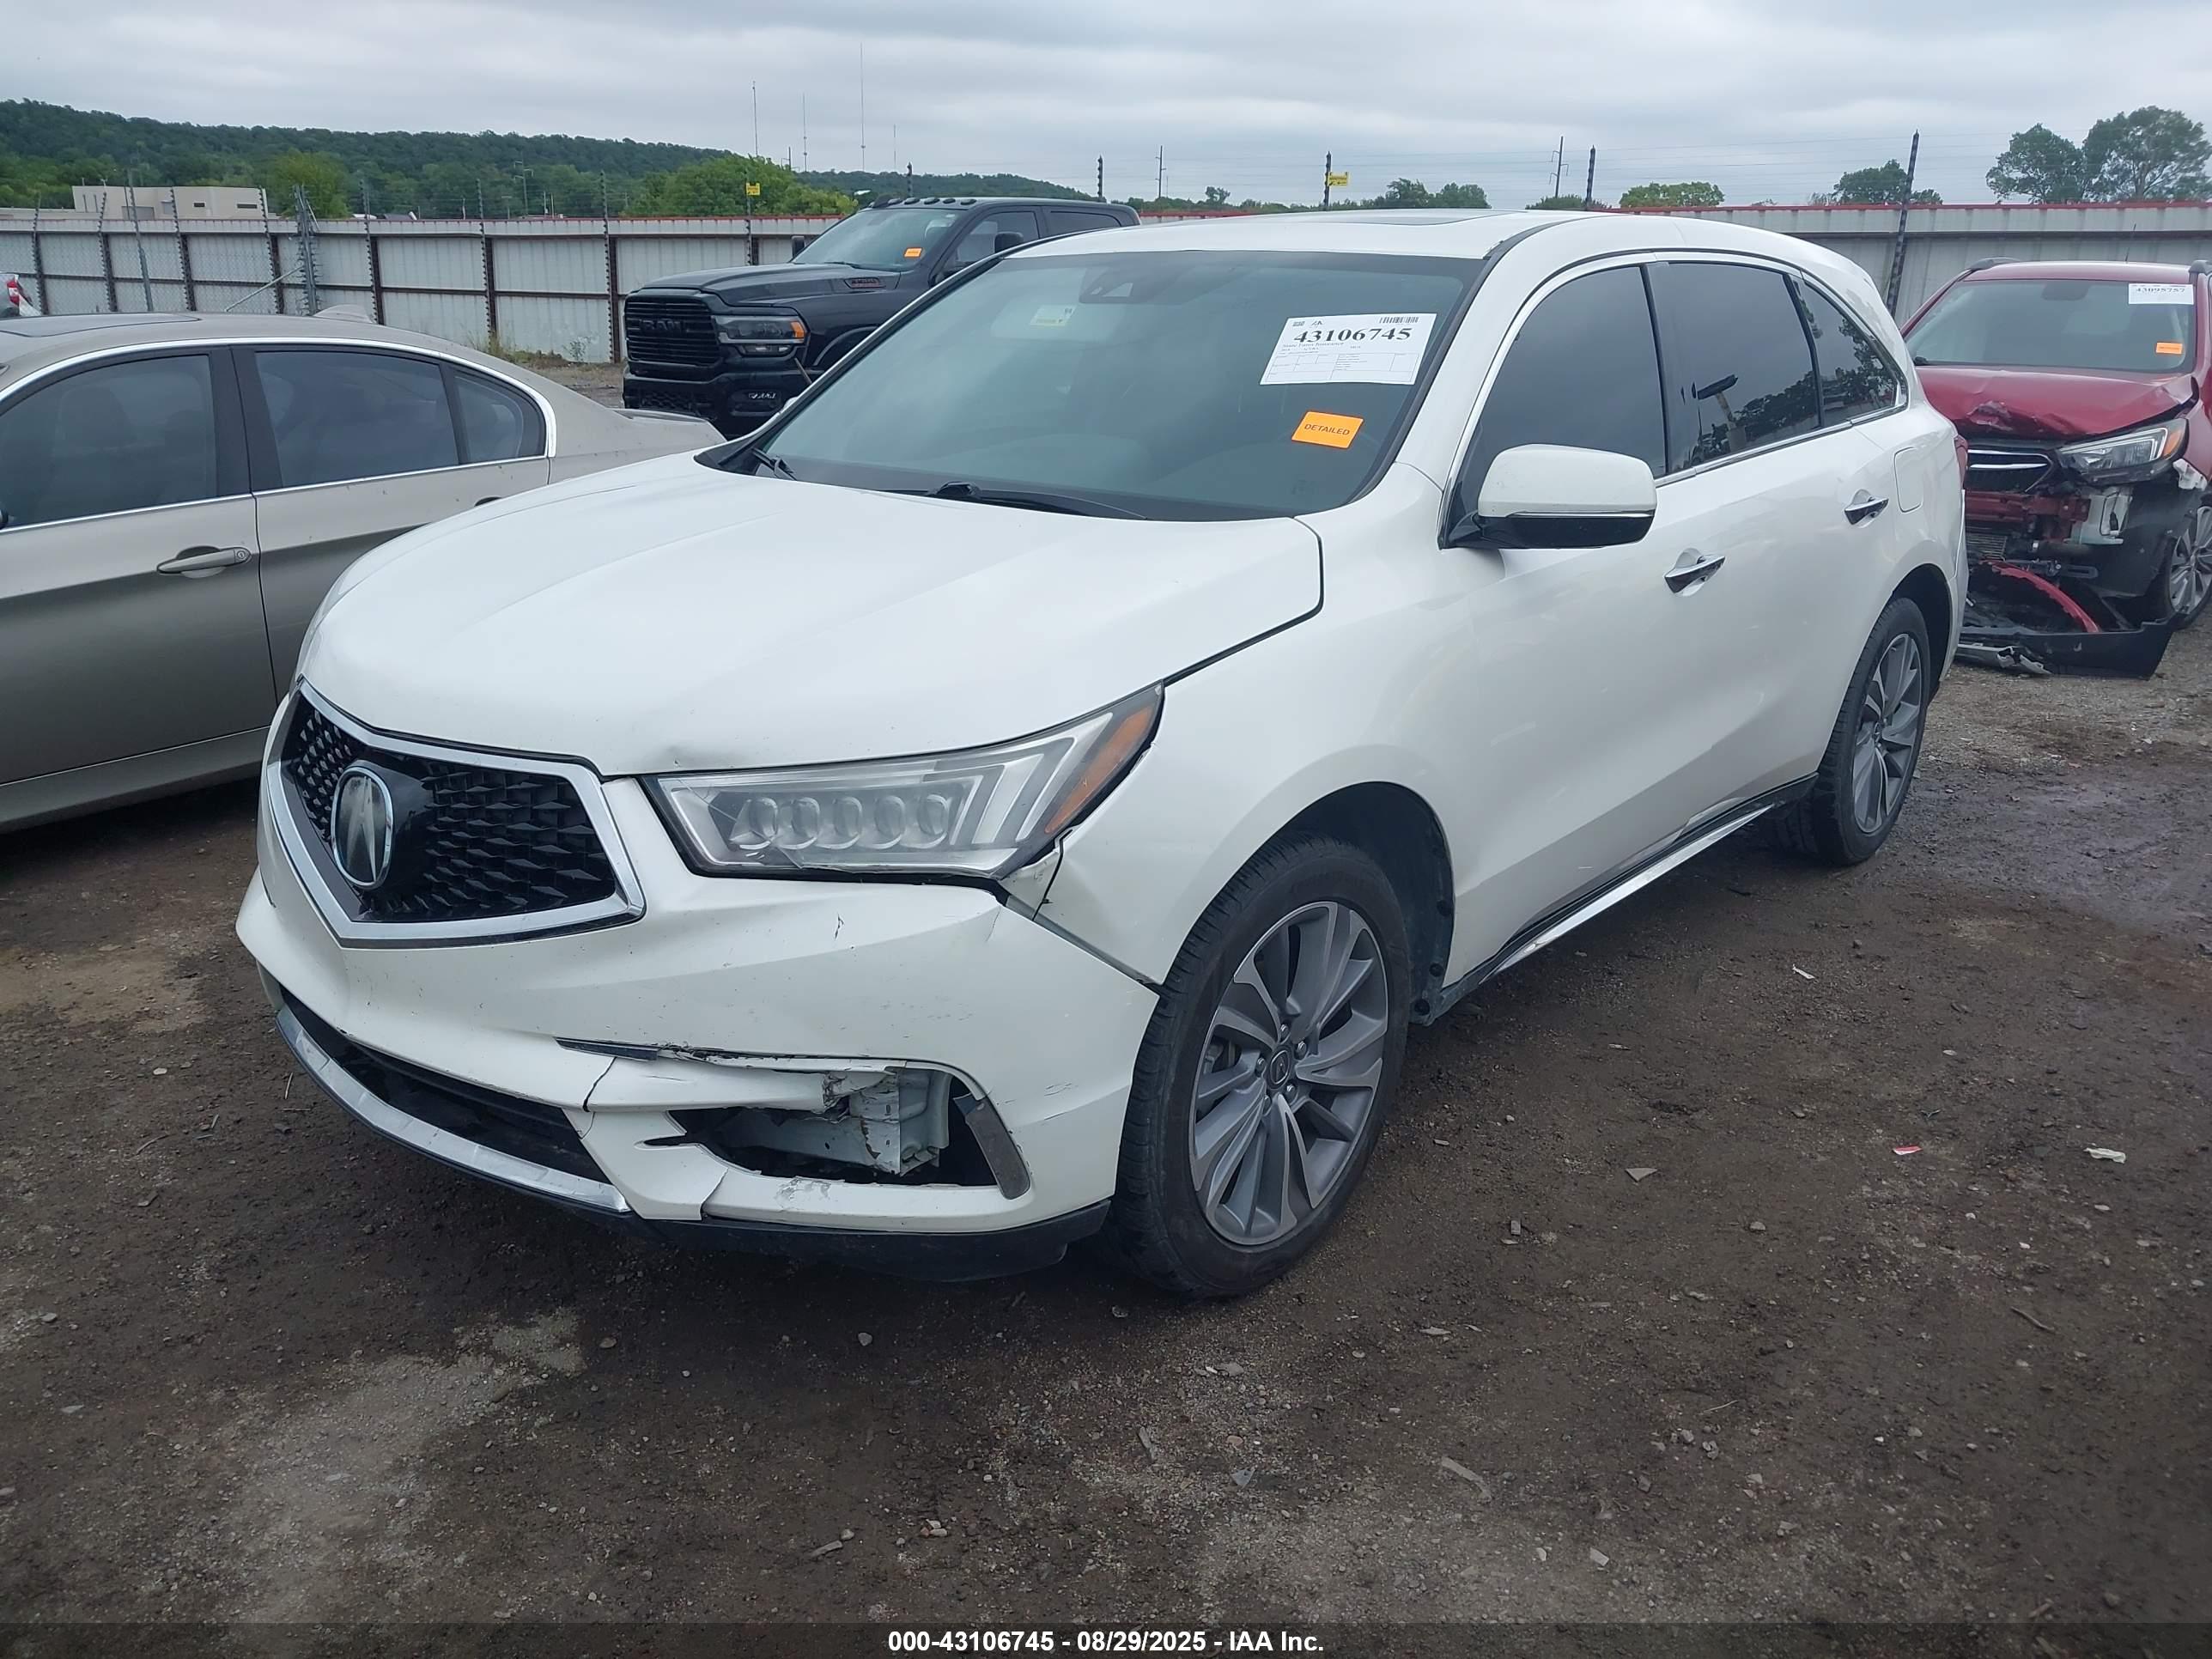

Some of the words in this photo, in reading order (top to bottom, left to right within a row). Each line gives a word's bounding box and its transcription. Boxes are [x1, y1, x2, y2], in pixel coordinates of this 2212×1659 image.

[642, 319, 681, 331] RAM
[1293, 328, 1413, 343] 43106745
[1304, 423, 1351, 435] DETAILED
